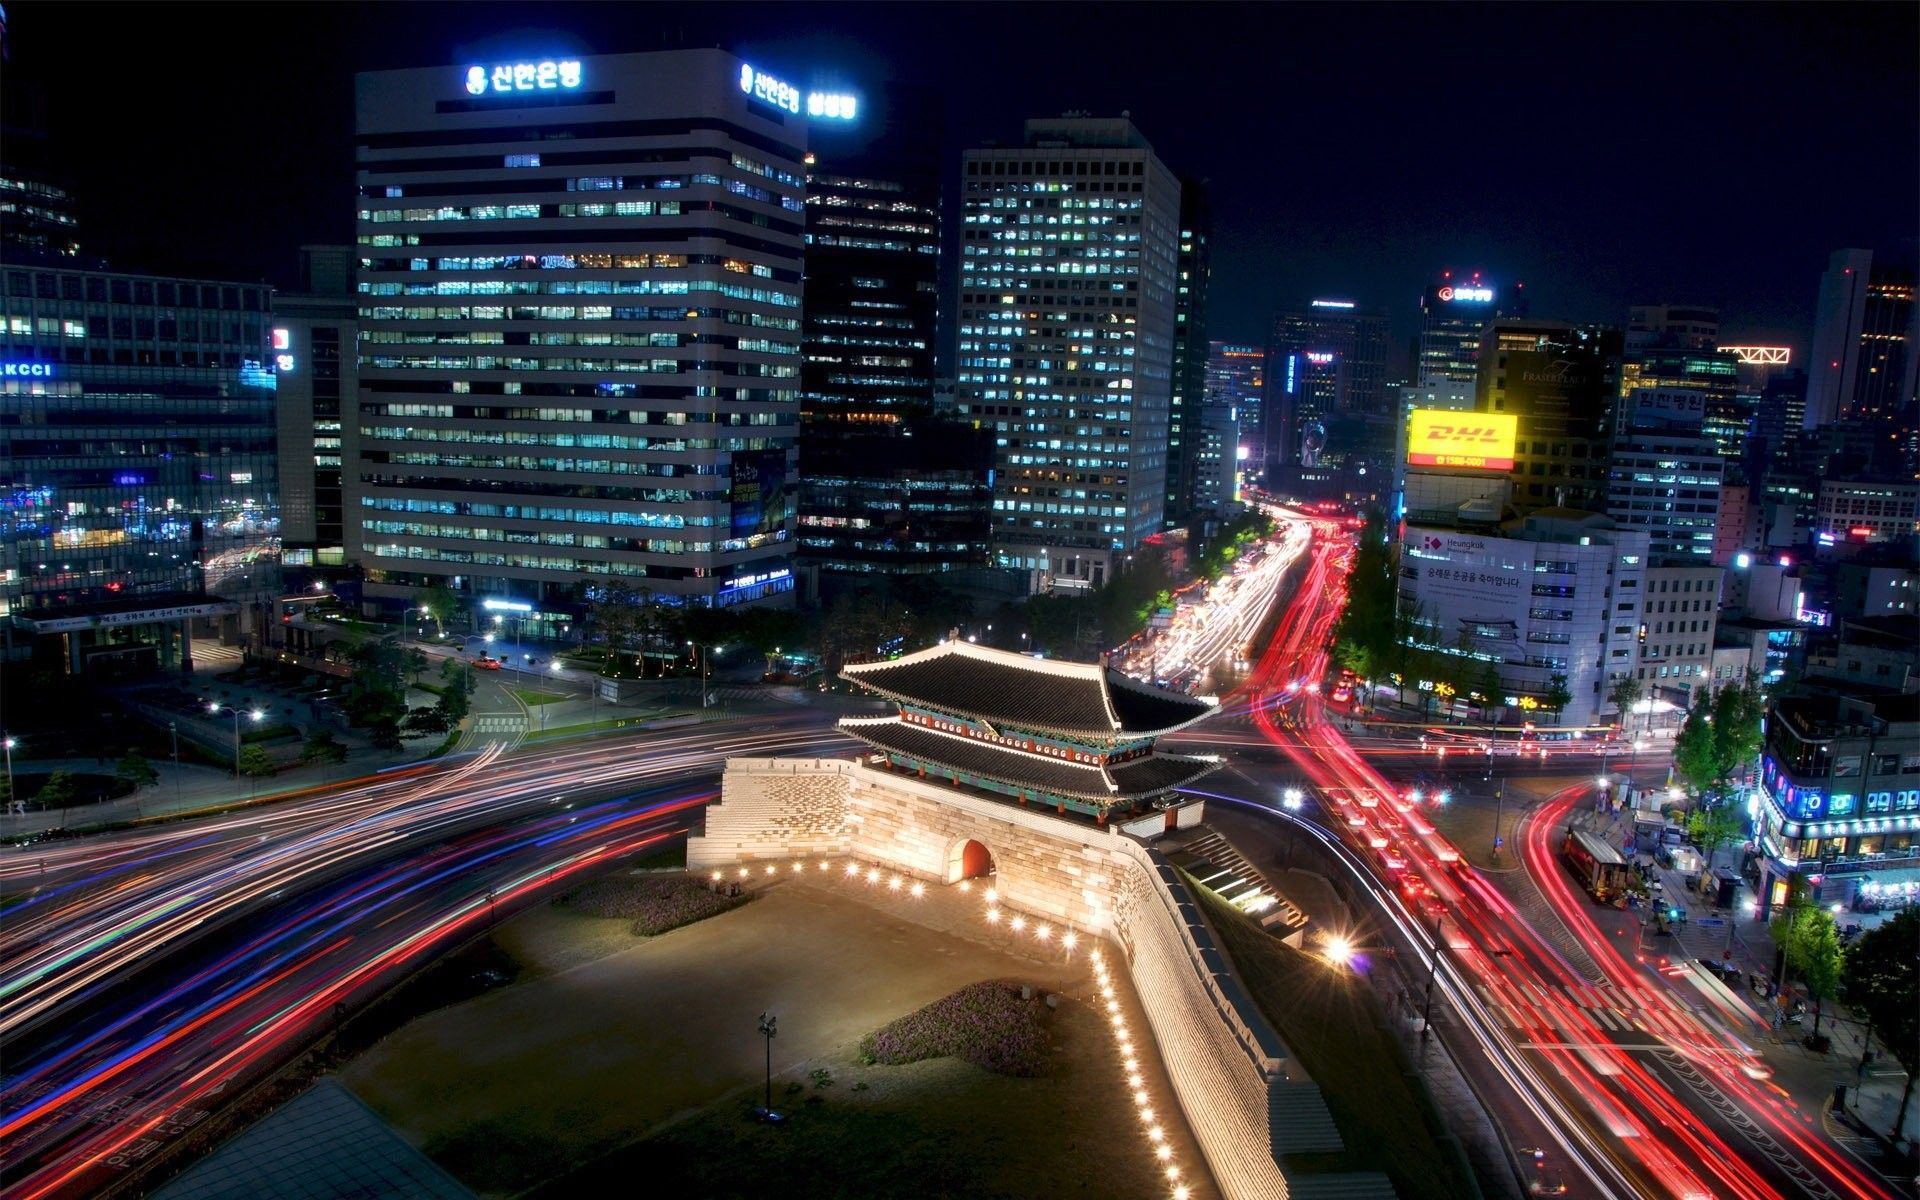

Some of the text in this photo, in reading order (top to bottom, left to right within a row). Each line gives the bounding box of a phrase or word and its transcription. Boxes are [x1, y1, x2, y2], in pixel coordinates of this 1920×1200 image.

[491, 61, 581, 91] 신한은행
[5, 363, 51, 376] KCCI
[1640, 392, 1702, 411] 힘찬병원
[1427, 425, 1500, 443] DHL
[1447, 539, 1485, 550] Heungkuk
[1453, 571, 1476, 583] 준공을
